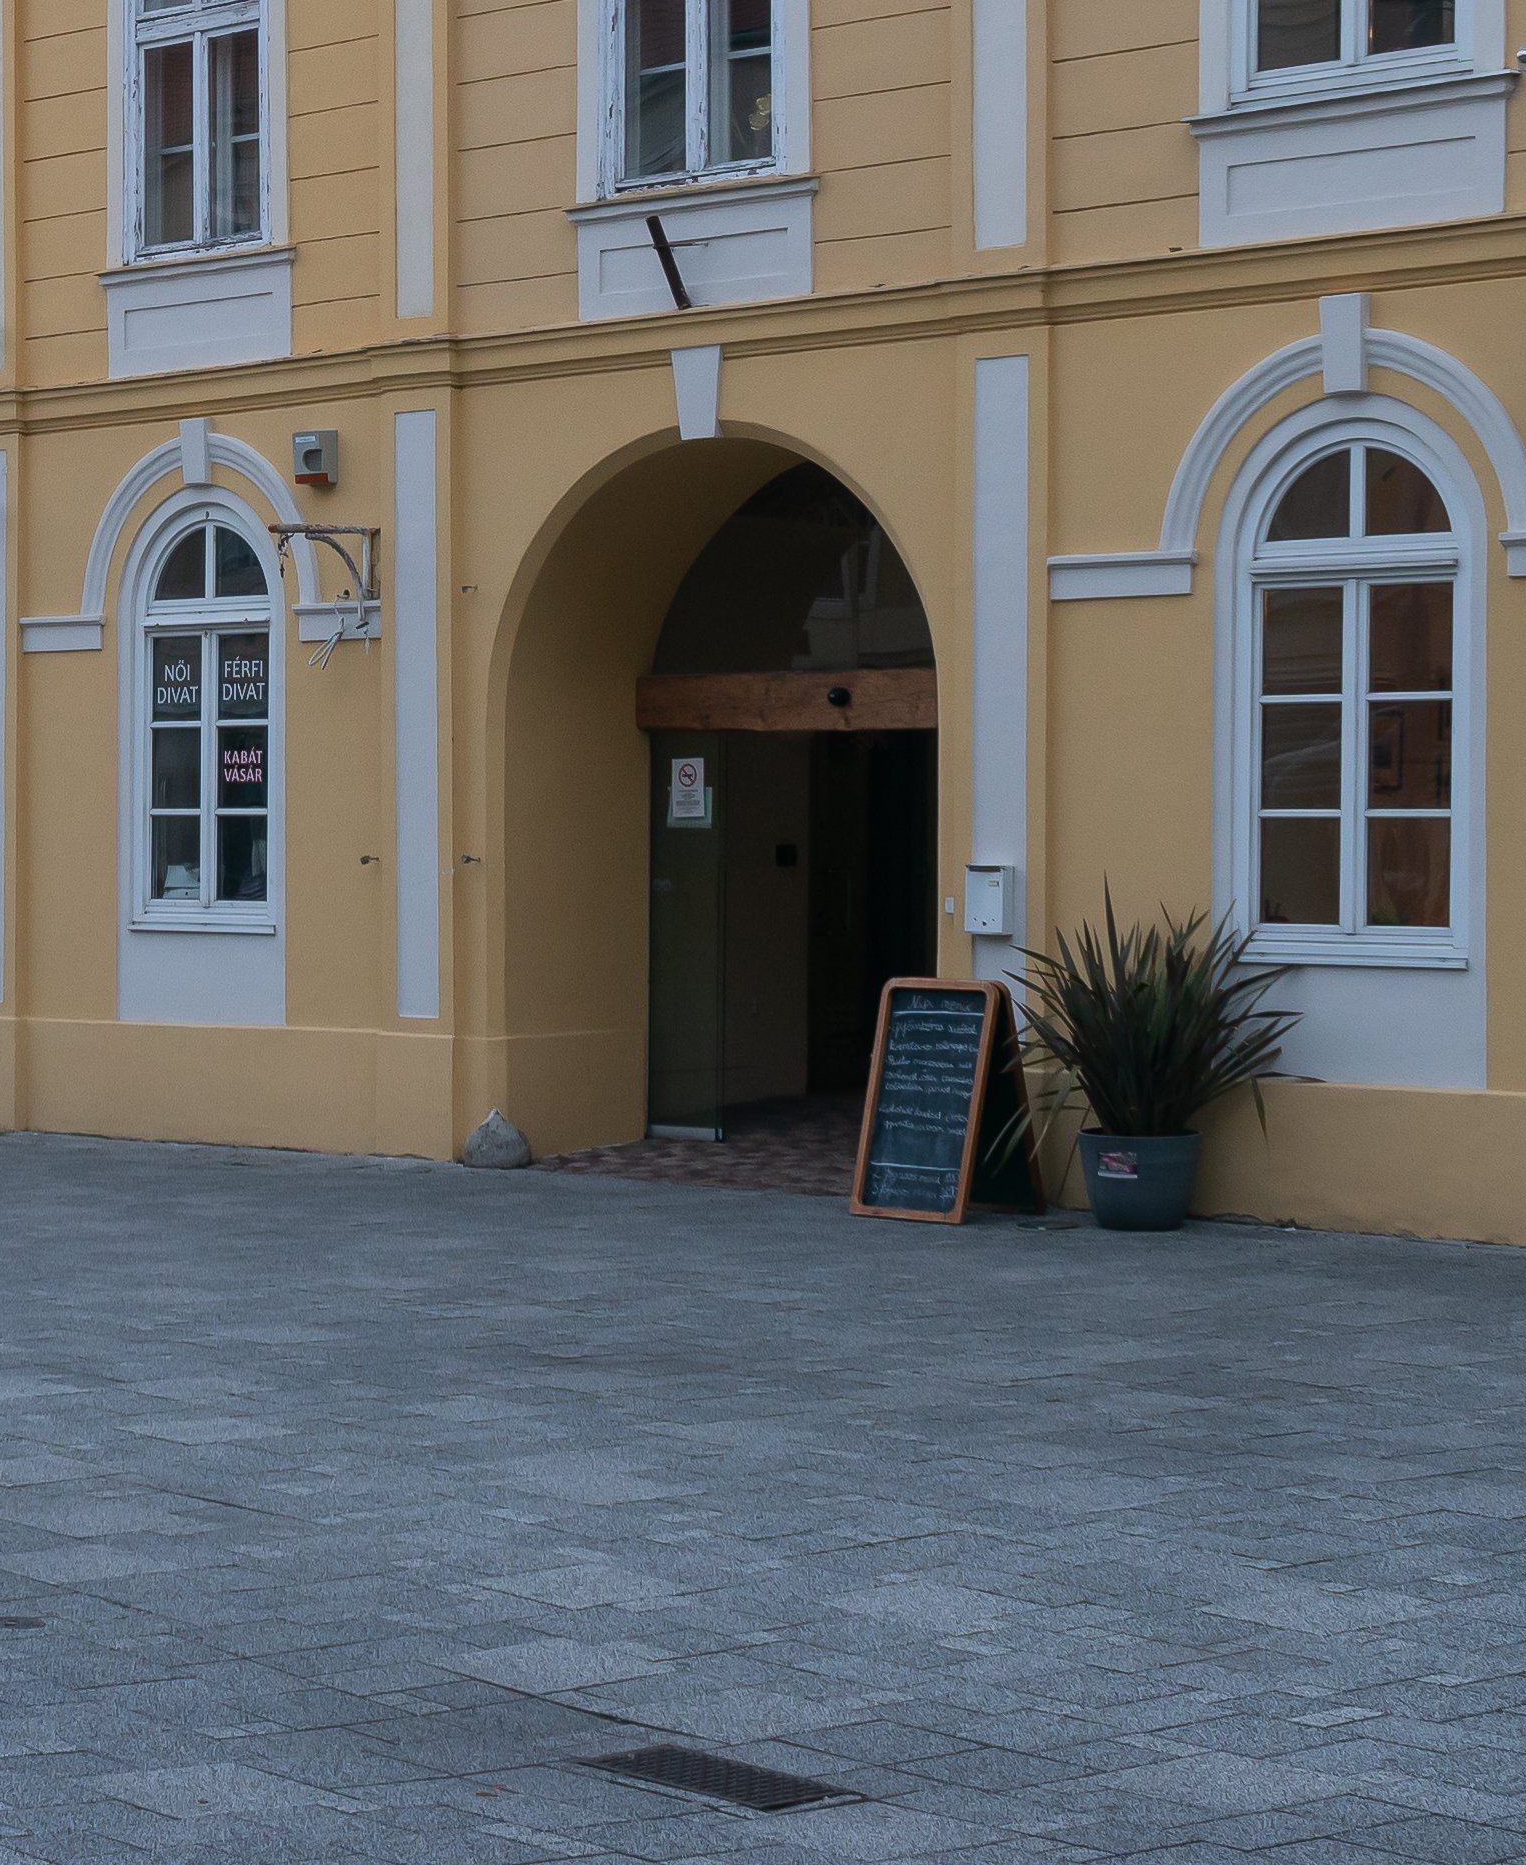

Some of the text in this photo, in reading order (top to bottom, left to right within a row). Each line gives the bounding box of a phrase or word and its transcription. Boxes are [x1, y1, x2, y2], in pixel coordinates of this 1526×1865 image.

[164, 659, 191, 682] NŐI
[224, 655, 263, 678] FÉRFI
[157, 686, 199, 704] DIVAT
[222, 682, 266, 701] DIVAT
[224, 746, 263, 764] KABÁT
[224, 765, 263, 783] VÁSÁR
